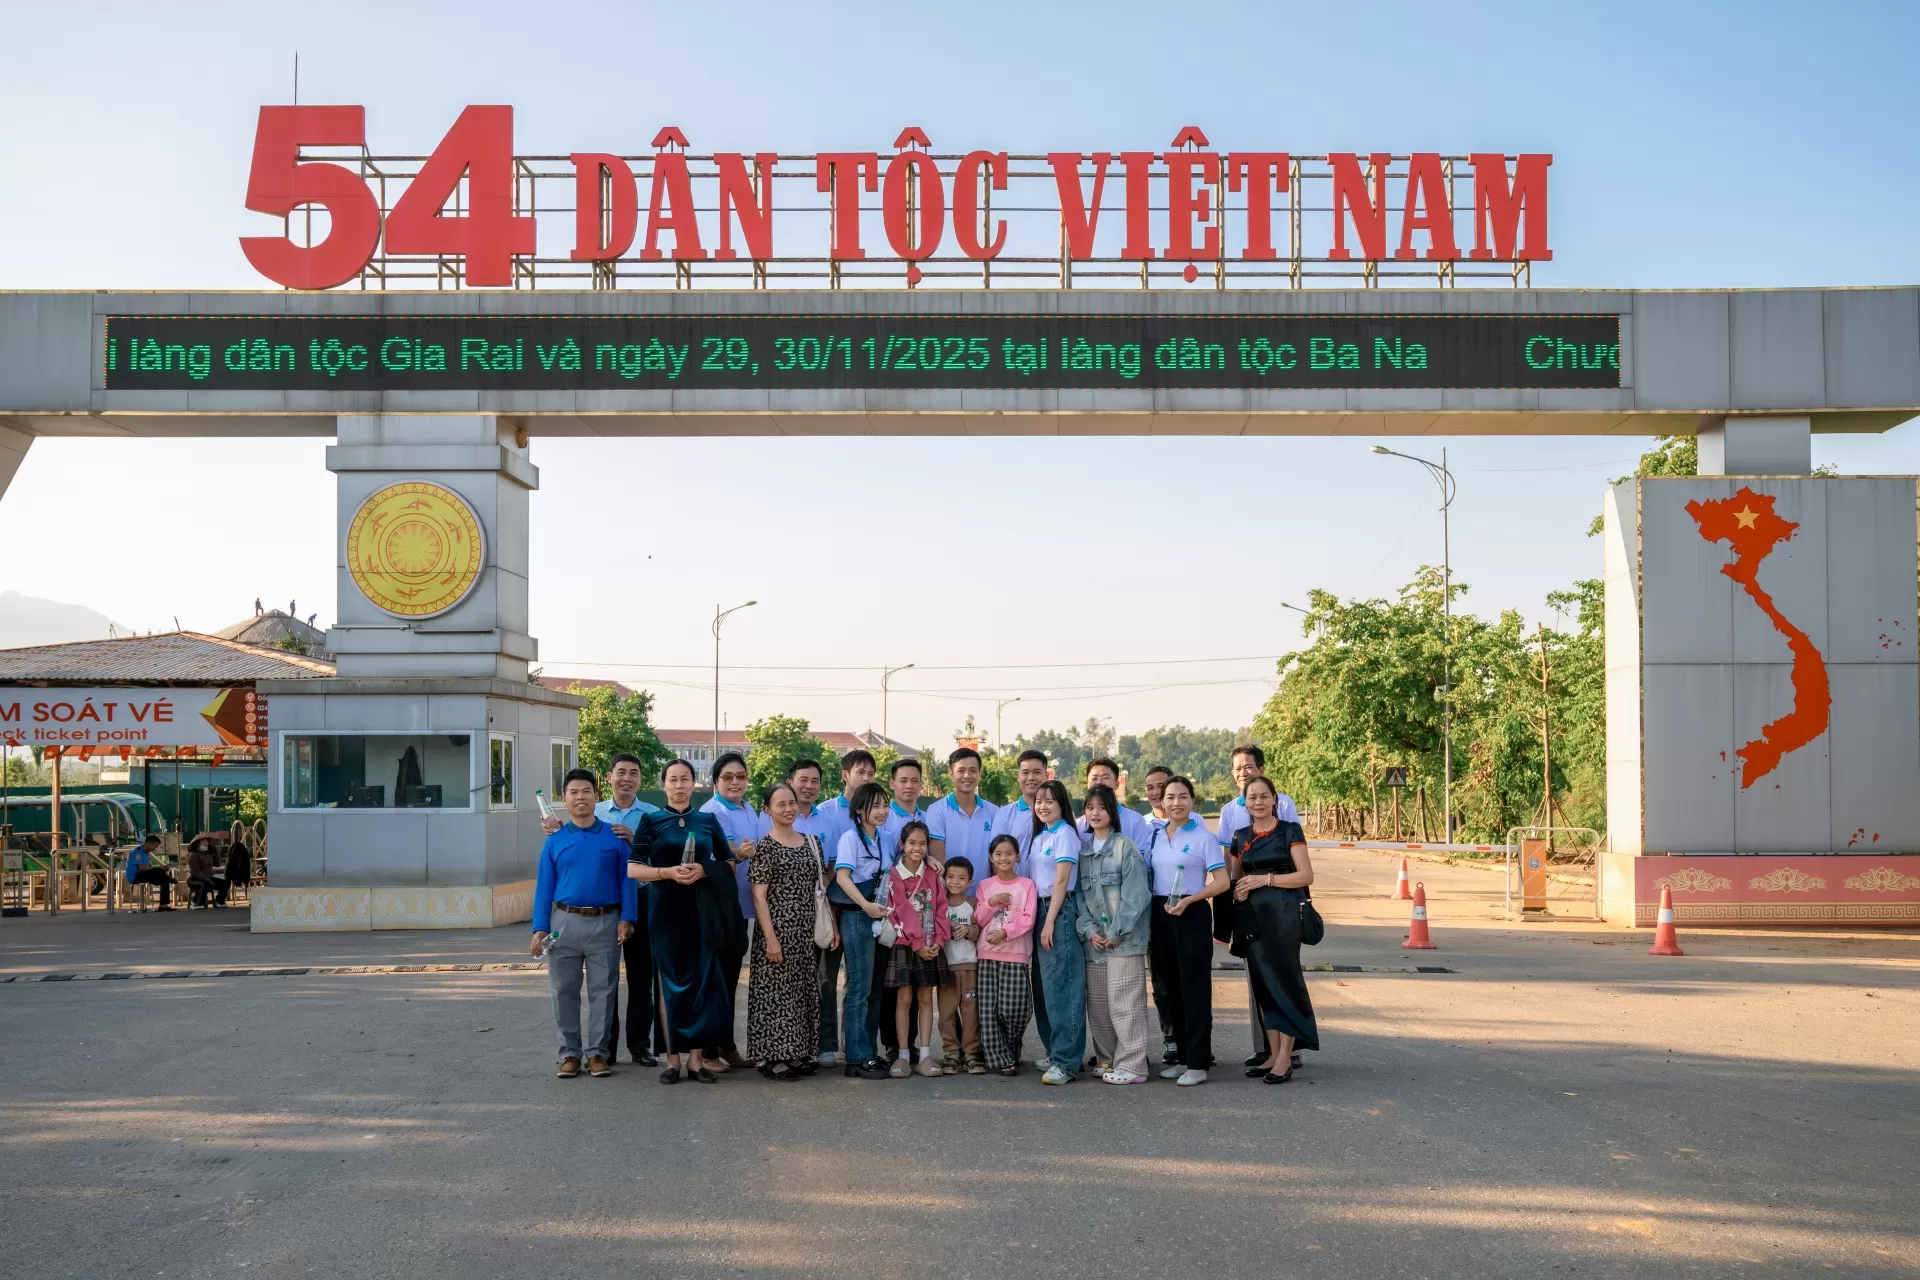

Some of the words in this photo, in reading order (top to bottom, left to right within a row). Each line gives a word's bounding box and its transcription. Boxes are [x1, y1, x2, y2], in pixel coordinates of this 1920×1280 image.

[239, 105, 536, 289] 54
[570, 126, 778, 261] DÂN
[815, 126, 1008, 283] TỘC
[1047, 126, 1290, 282] VIỆT
[1326, 152, 1553, 261] NAM
[130, 338, 211, 380] làng
[224, 338, 296, 370] dân
[308, 337, 369, 377] tộc
[380, 336, 447, 370] Gia
[461, 338, 524, 370] Rai
[535, 338, 582, 370] và
[595, 337, 690, 379] ngày
[700, 338, 760, 376] 29,
[773, 335, 991, 370] 30/11/2025
[1001, 337, 1048, 376] tại
[1061, 337, 1141, 379] làng
[1154, 337, 1225, 370] dân
[1237, 337, 1298, 376] tộc
[1309, 338, 1361, 370] Ba
[1374, 338, 1428, 370] Na
[33, 696, 118, 723] SOÁT
[129, 696, 174, 722] VÉ
[34, 728, 91, 740] ticket
[97, 728, 148, 743] point
